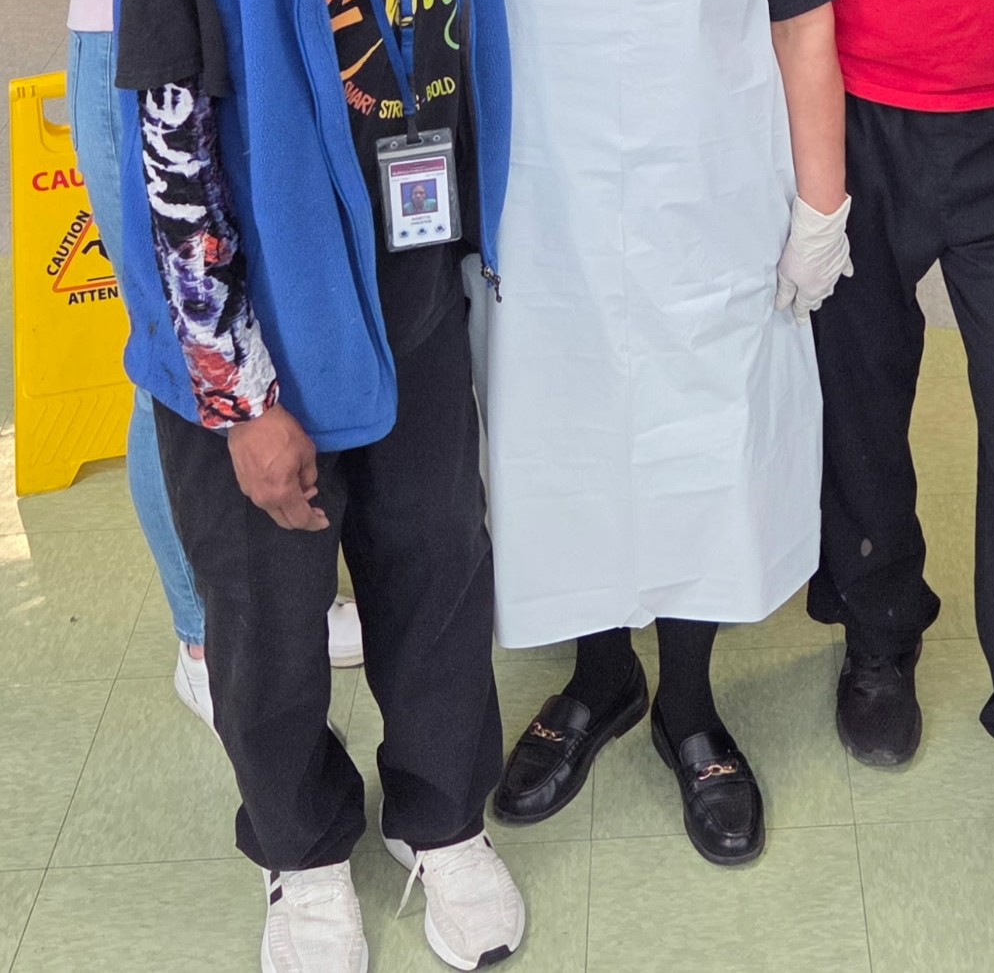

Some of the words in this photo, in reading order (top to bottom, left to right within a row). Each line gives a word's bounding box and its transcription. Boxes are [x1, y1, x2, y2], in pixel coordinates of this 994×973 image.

[426, 76, 456, 102] BOLD
[47, 210, 91, 276] CAUTION
[68, 286, 119, 305] ATTEN
